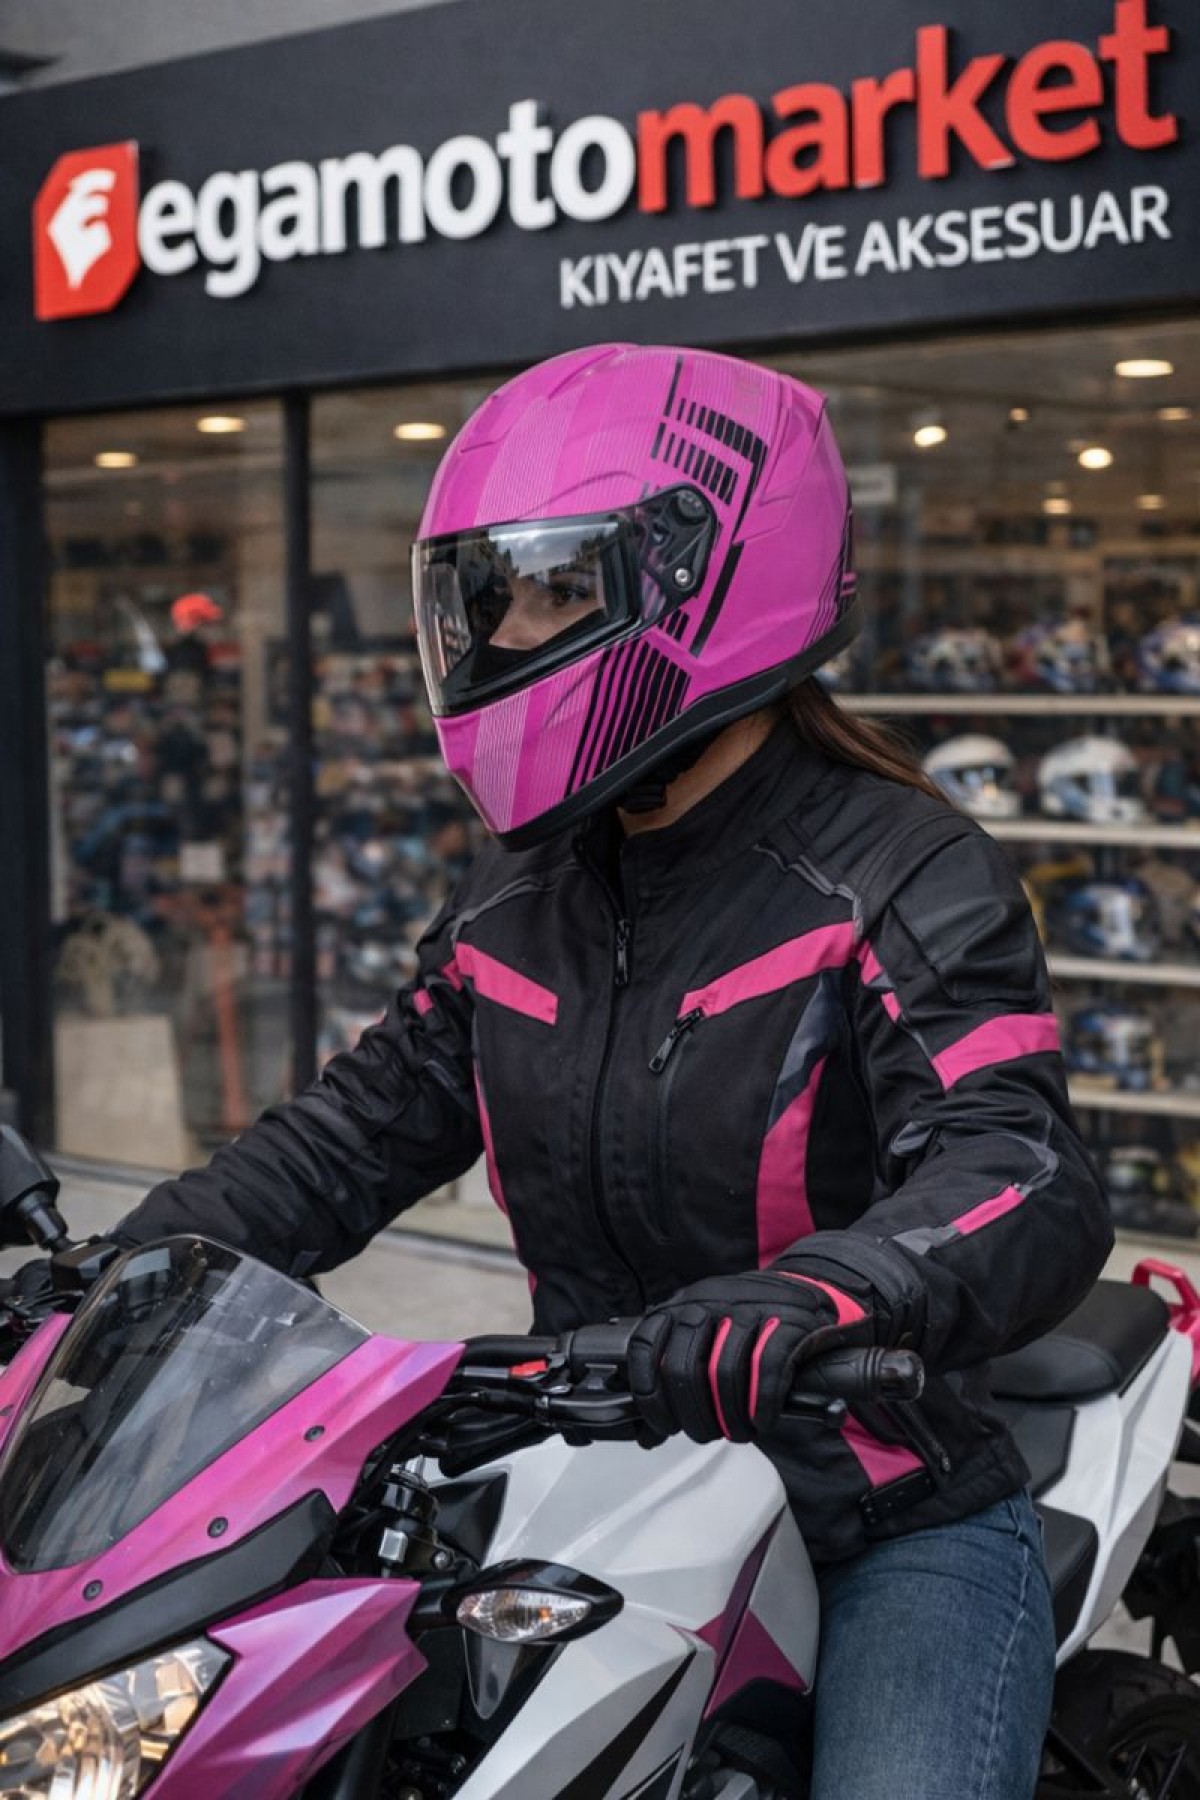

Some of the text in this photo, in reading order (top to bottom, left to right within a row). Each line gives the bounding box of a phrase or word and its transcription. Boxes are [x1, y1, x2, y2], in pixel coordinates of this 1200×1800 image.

[138, 0, 1178, 298] egamotomarket
[559, 185, 1171, 308] KIYAFET VE AKSESUAR
